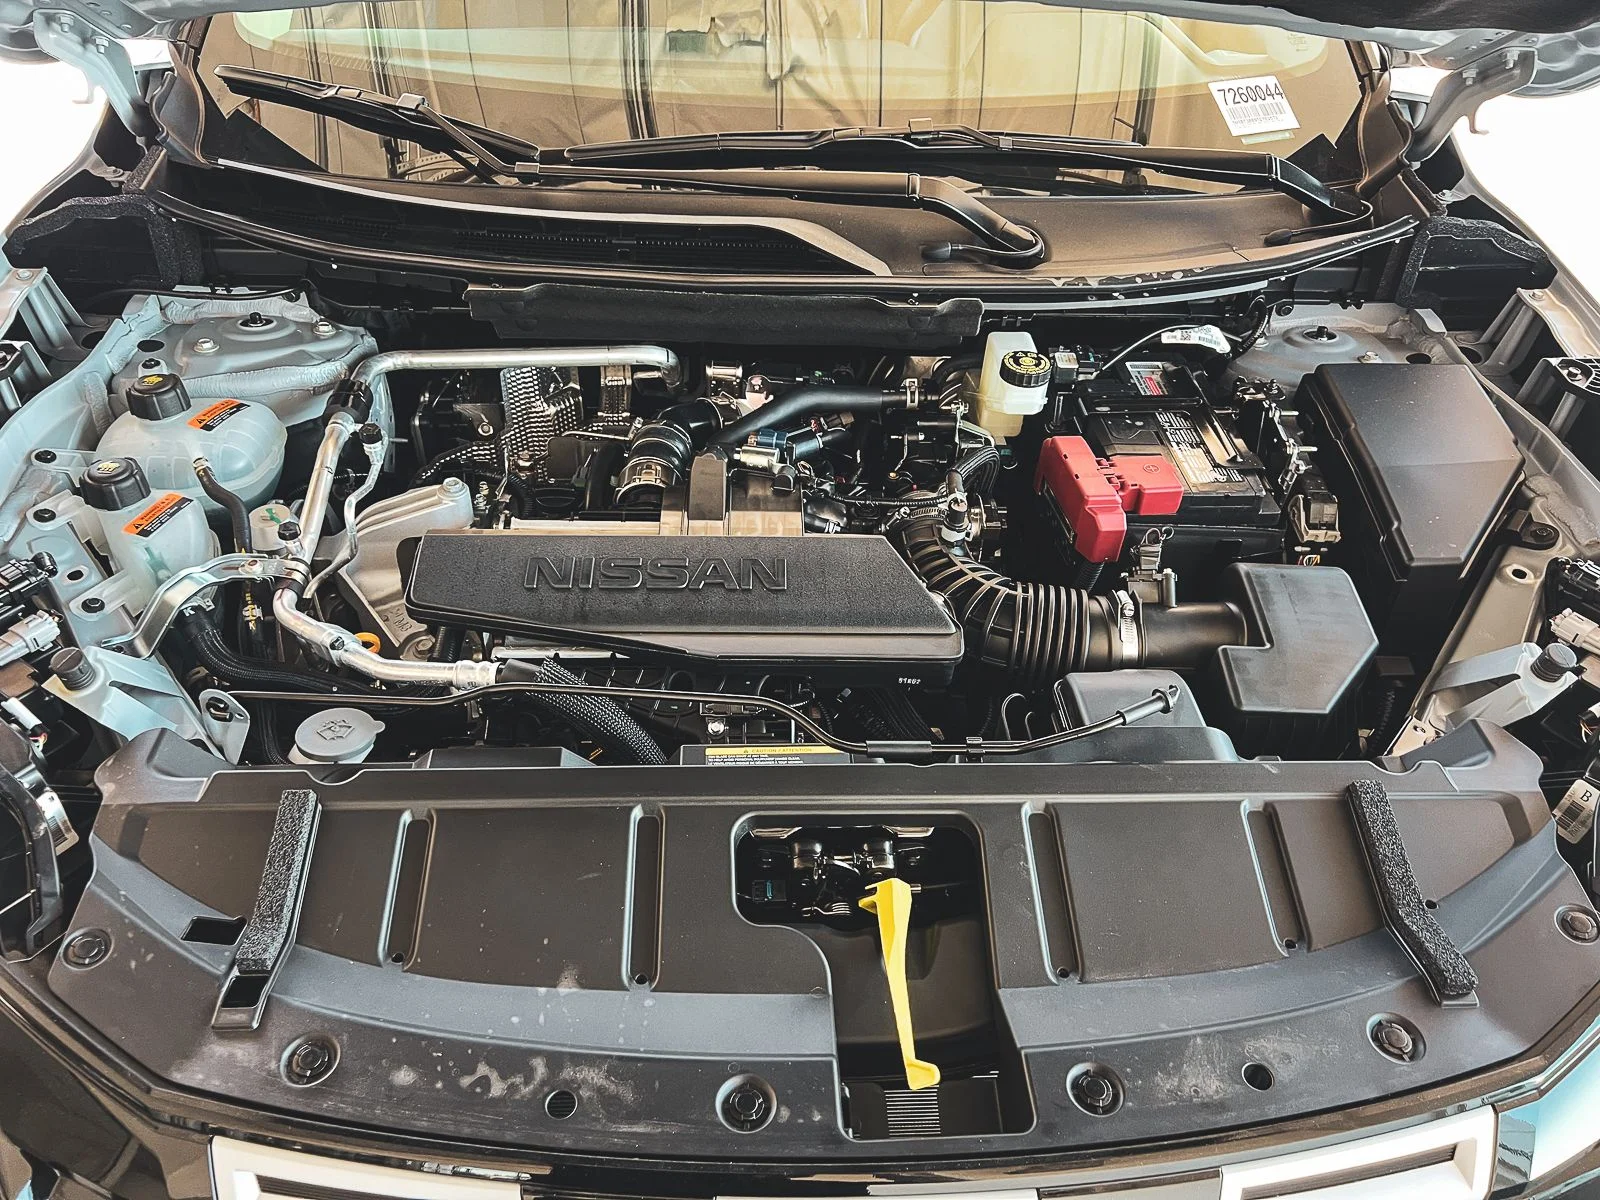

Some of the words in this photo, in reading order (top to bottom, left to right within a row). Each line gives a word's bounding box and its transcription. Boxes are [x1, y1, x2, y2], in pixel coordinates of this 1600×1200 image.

[1217, 82, 1284, 106] 7260044
[523, 556, 788, 590] NISSAN
[1580, 789, 1593, 803] B
